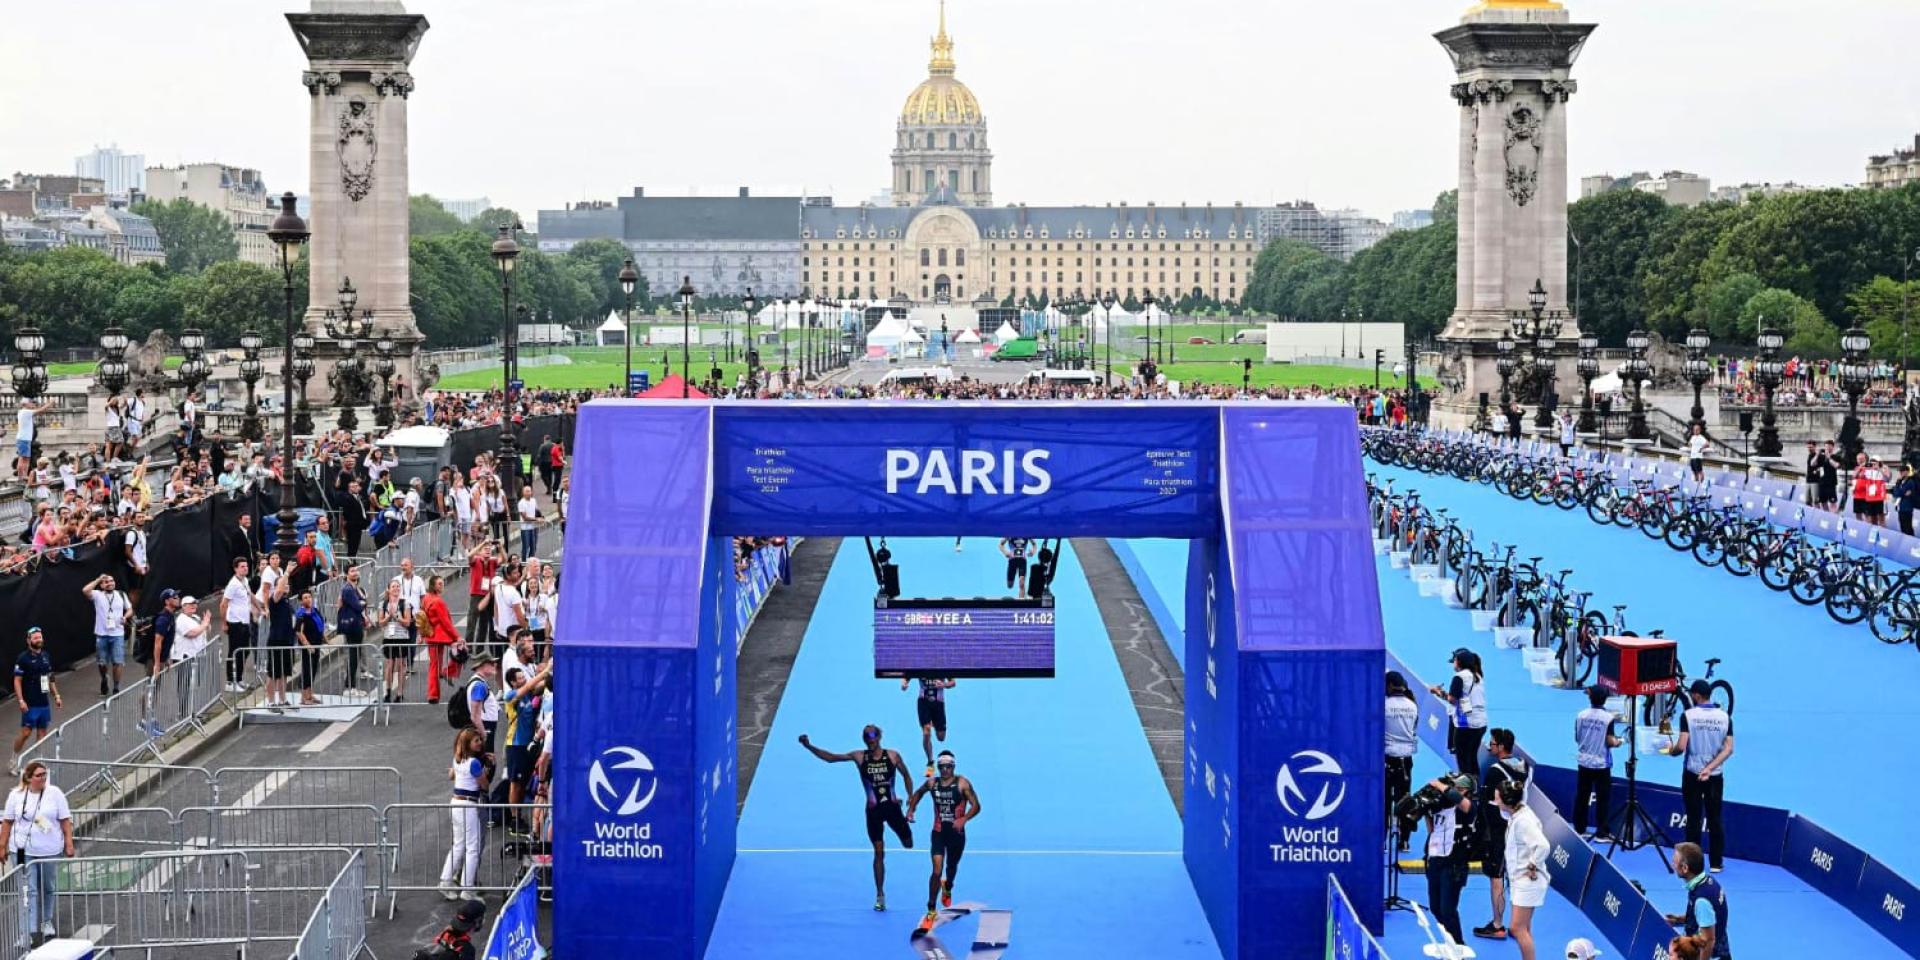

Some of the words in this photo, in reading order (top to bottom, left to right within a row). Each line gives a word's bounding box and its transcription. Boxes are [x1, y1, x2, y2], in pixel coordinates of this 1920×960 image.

[1176, 450, 1191, 458] Test
[753, 475, 766, 484] Test
[886, 449, 1052, 495] PARIS
[935, 613, 960, 625] YEE
[962, 613, 972, 625] A
[1013, 612, 1053, 624] 1:41:02
[594, 822, 651, 839] World
[1670, 812, 1709, 833] PAI
[1283, 826, 1339, 843] World
[582, 840, 663, 859] Triathlon
[1269, 844, 1352, 863] Triathlon
[1553, 845, 1570, 869] PARIS
[1811, 847, 1834, 872] PARIS
[1603, 890, 1622, 918] PARIS
[1882, 892, 1906, 920] PARIS
